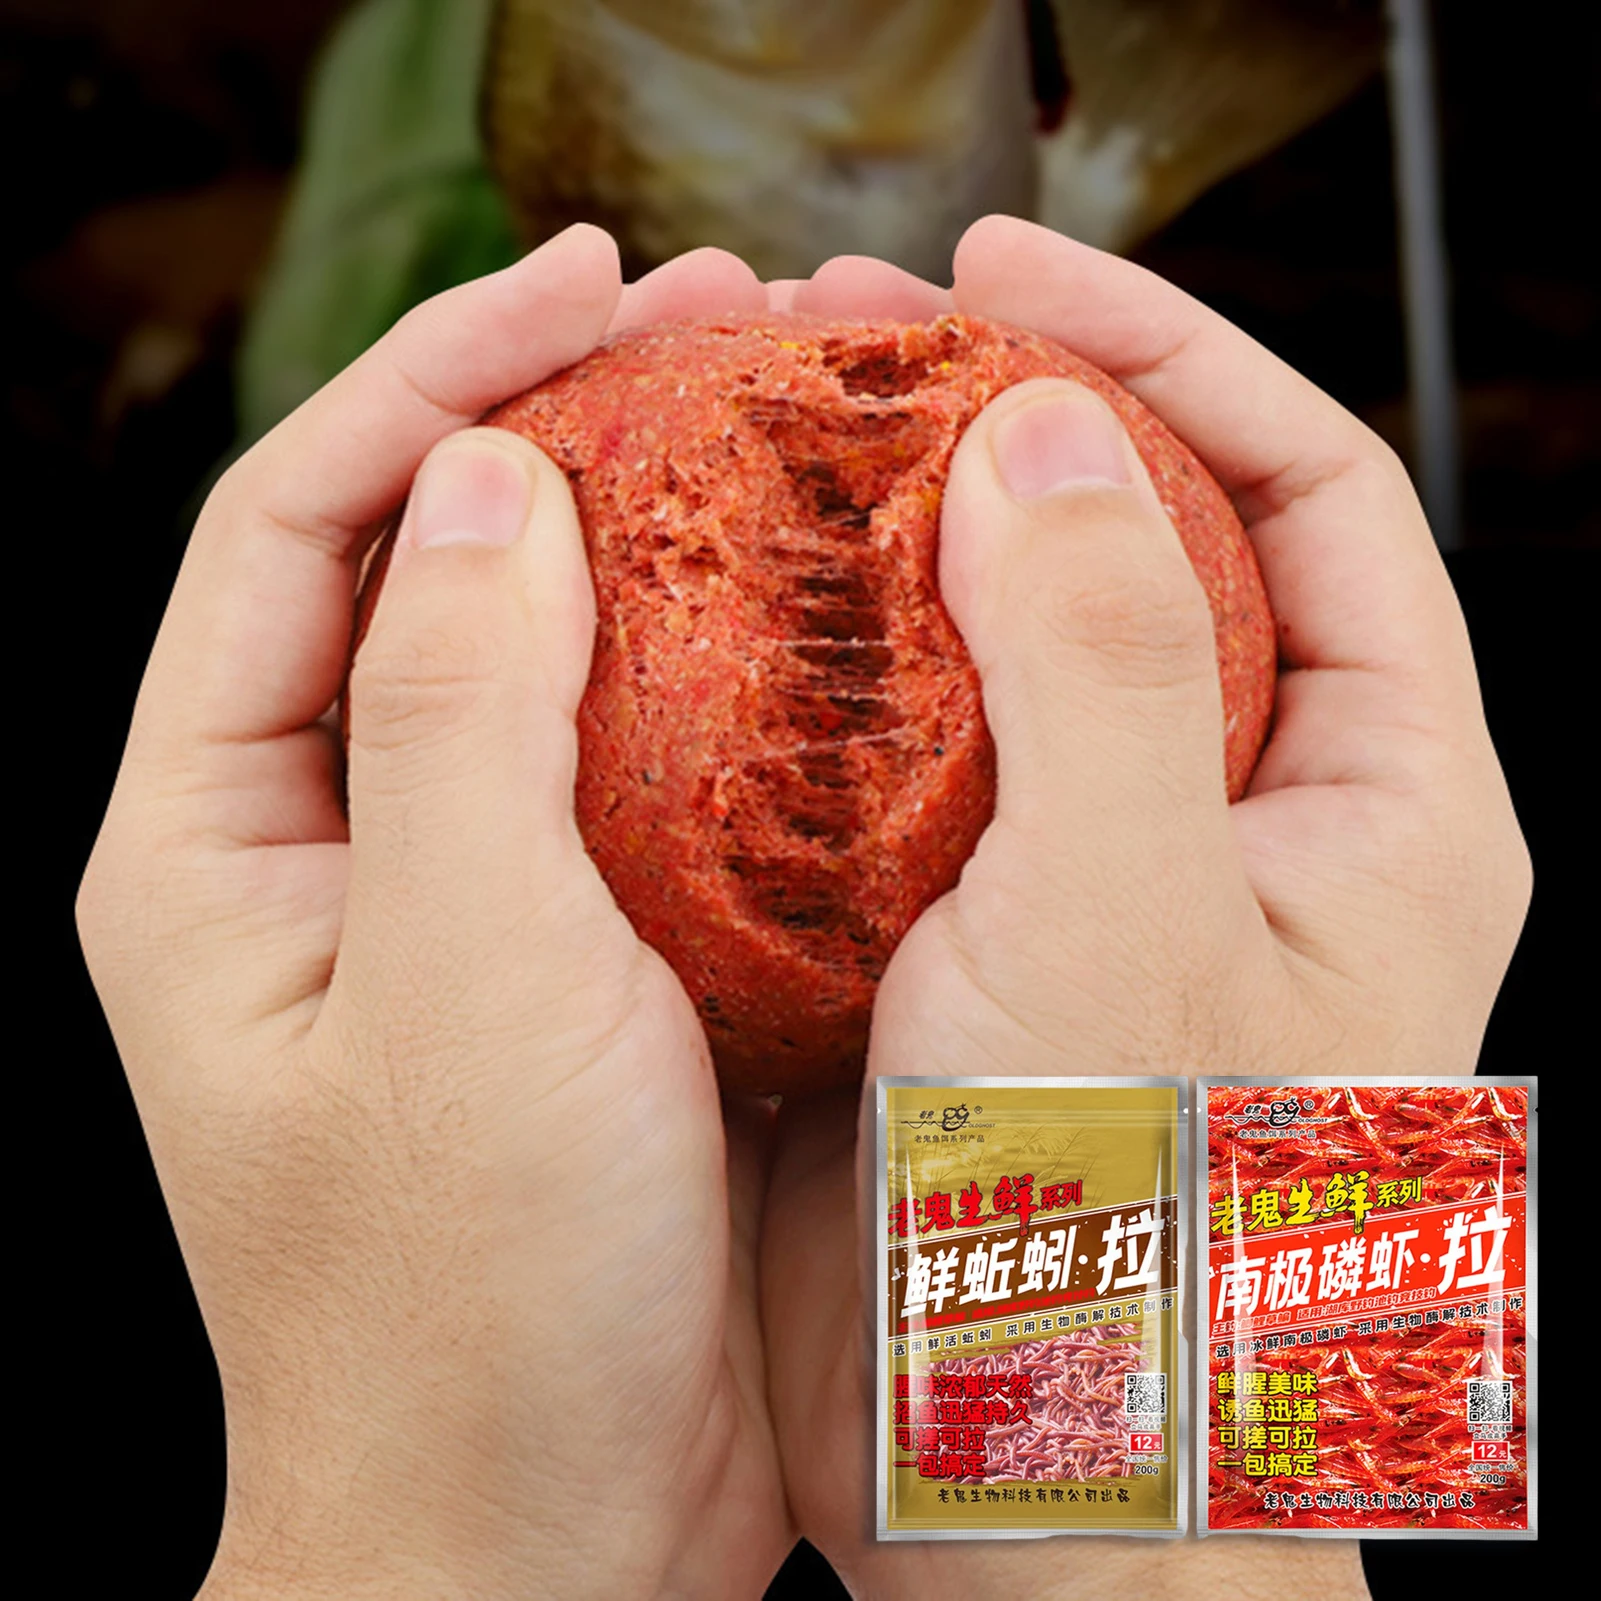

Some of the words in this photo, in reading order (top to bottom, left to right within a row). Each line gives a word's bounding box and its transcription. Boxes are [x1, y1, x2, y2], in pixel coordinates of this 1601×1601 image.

[915, 1134, 985, 1143] 老鬼鱼饵系列产品
[1240, 1130, 1316, 1138] 老鬼鱼饵系列产品
[888, 1174, 1083, 1236] 老鬼生鲜系列
[1210, 1170, 1423, 1235] 老鬼生鲜系列
[893, 1328, 991, 1356] 选用鲜活蚯蚓
[1006, 1297, 1173, 1337] 采用生物酶解技术制作
[1216, 1325, 1347, 1358] 选用冰鲜南极磷虾
[1358, 1296, 1523, 1336] 采用生物酶解技术制作
[893, 1374, 1032, 1398] 腥味浓郁天然
[1217, 1372, 1318, 1396] 鲜腥美味
[893, 1400, 1032, 1424] 招鱼迅猛持久
[1217, 1399, 1318, 1423] 诱鱼迅猛
[893, 1428, 986, 1451] 可搓可拉
[1218, 1426, 1318, 1450] 可搓可拉
[893, 1454, 986, 1477] 一包搞定
[1135, 1465, 1159, 1475] 200g
[1217, 1453, 1318, 1477] 一包搞定
[1480, 1474, 1506, 1484] 200g
[937, 1488, 1130, 1503] 老鬼生物科技有限公司出品
[1263, 1492, 1476, 1509] 老鬼生物科技有限公司出品
